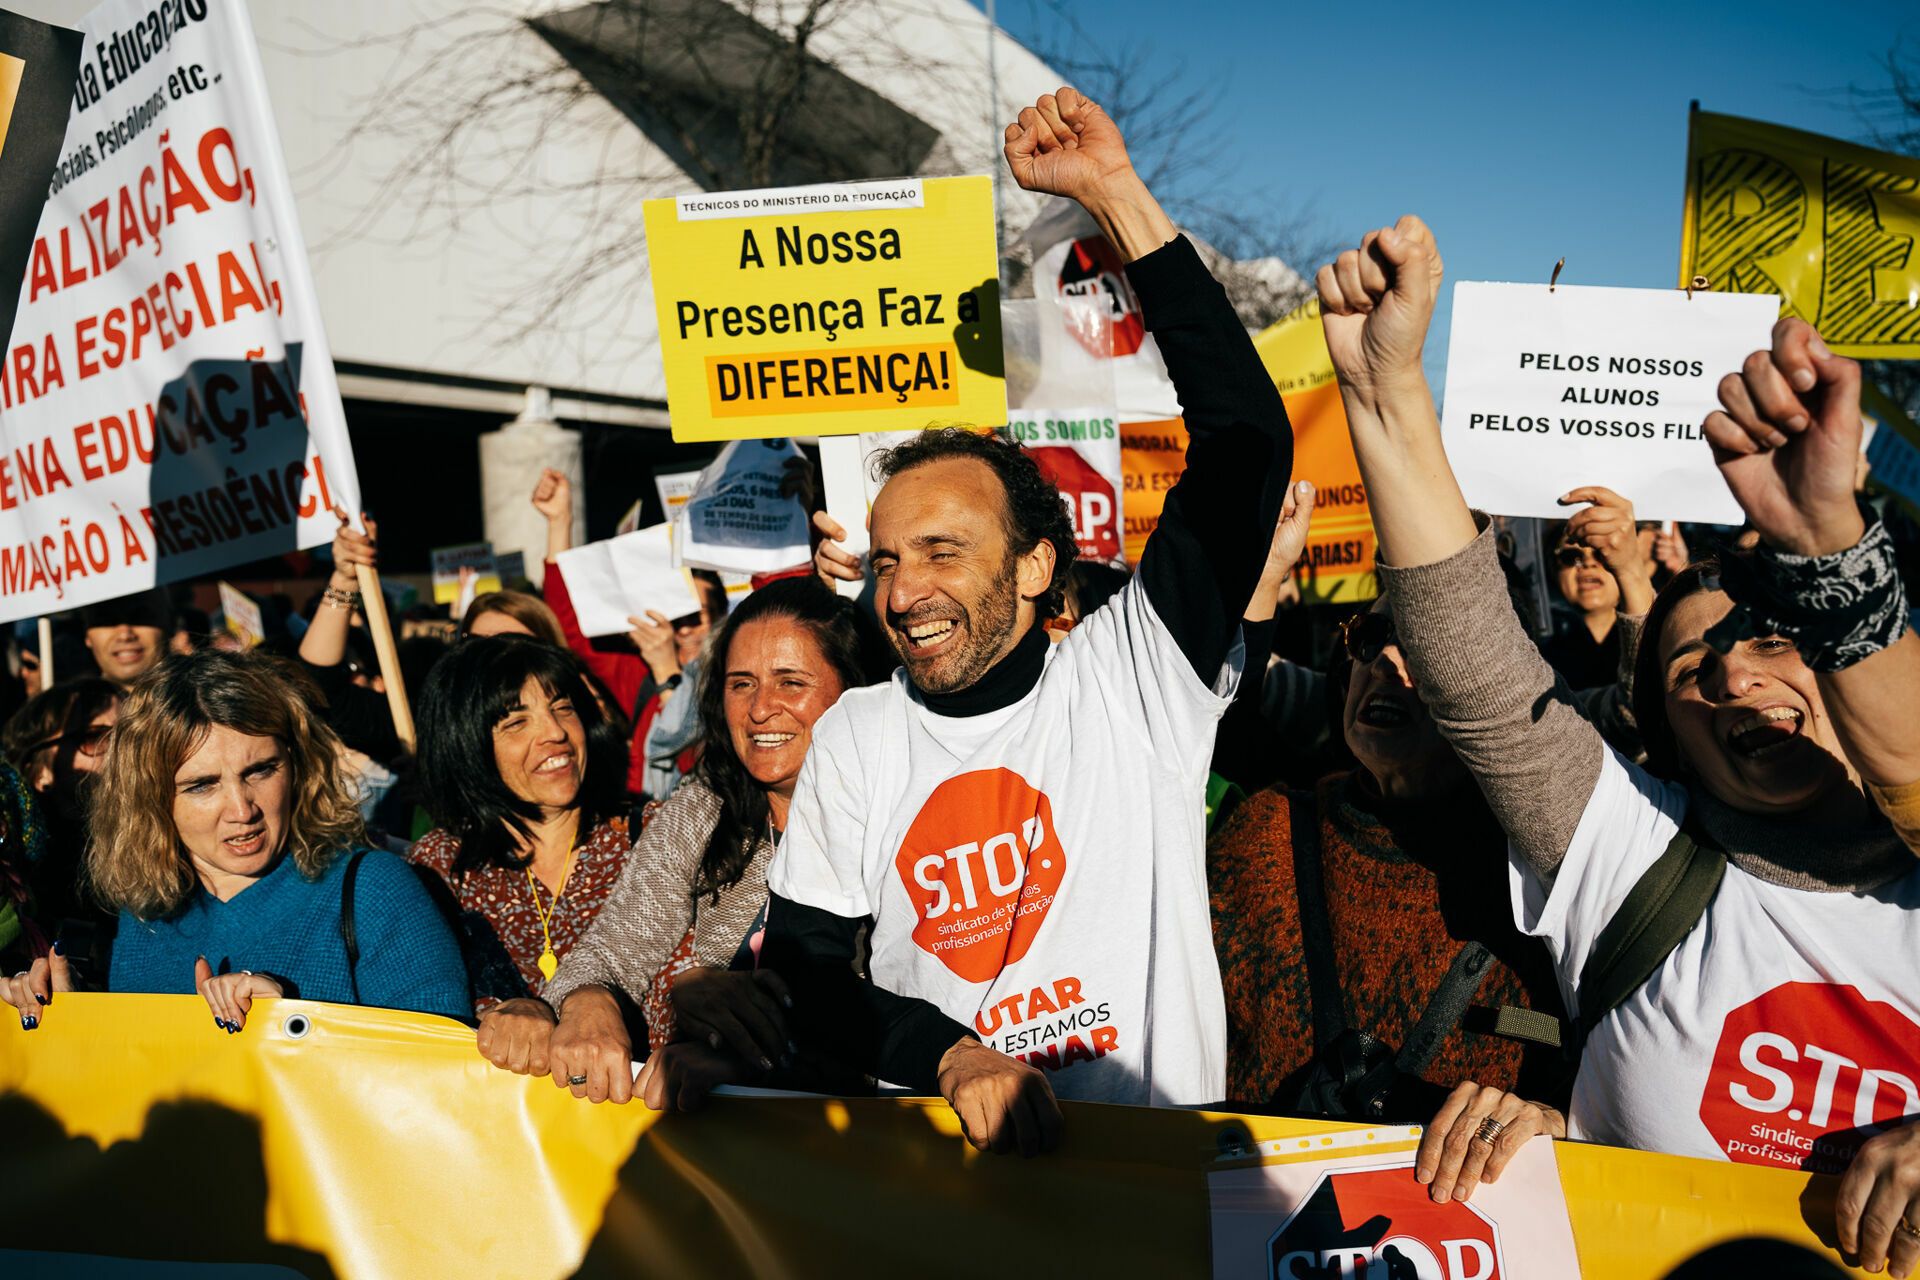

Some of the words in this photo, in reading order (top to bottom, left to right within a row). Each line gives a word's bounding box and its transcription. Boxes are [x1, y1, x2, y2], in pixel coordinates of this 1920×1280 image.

[24, 127, 256, 304] ALIZAÇÃO,
[683, 200, 740, 212] TÉCNICOS
[743, 199, 759, 209] DO
[762, 194, 830, 207] MINISTÉRIO
[834, 193, 849, 203] DA
[852, 189, 917, 203] EDUCAÇÃO
[739, 229, 764, 269] A
[775, 225, 901, 267] Nossa
[676, 298, 864, 341] Presença
[878, 287, 944, 328] Faz
[957, 291, 980, 324] a
[0, 333, 65, 414] IRA
[716, 350, 951, 403] DIFERENÇA!
[1519, 352, 1600, 373] PELOS
[1608, 357, 1704, 377] NOSSOS
[1561, 386, 1660, 406] ALUNOS
[1012, 420, 1040, 441] OS
[1045, 418, 1115, 441] SOMOS
[1469, 413, 1550, 434] PELOS
[1560, 418, 1655, 439] VOSSOS
[0, 436, 72, 511] ENA
[1314, 484, 1365, 508] UNOS
[2, 517, 111, 600] MAÇÃO
[112, 502, 148, 567] À
[140, 455, 334, 558] RESIDÊNCI
[931, 923, 1003, 953] profissionais
[937, 915, 990, 935] sindicato
[992, 907, 1006, 920] de
[975, 977, 1086, 1037] UTAR
[1005, 1002, 1111, 1053] ESTAMOS
